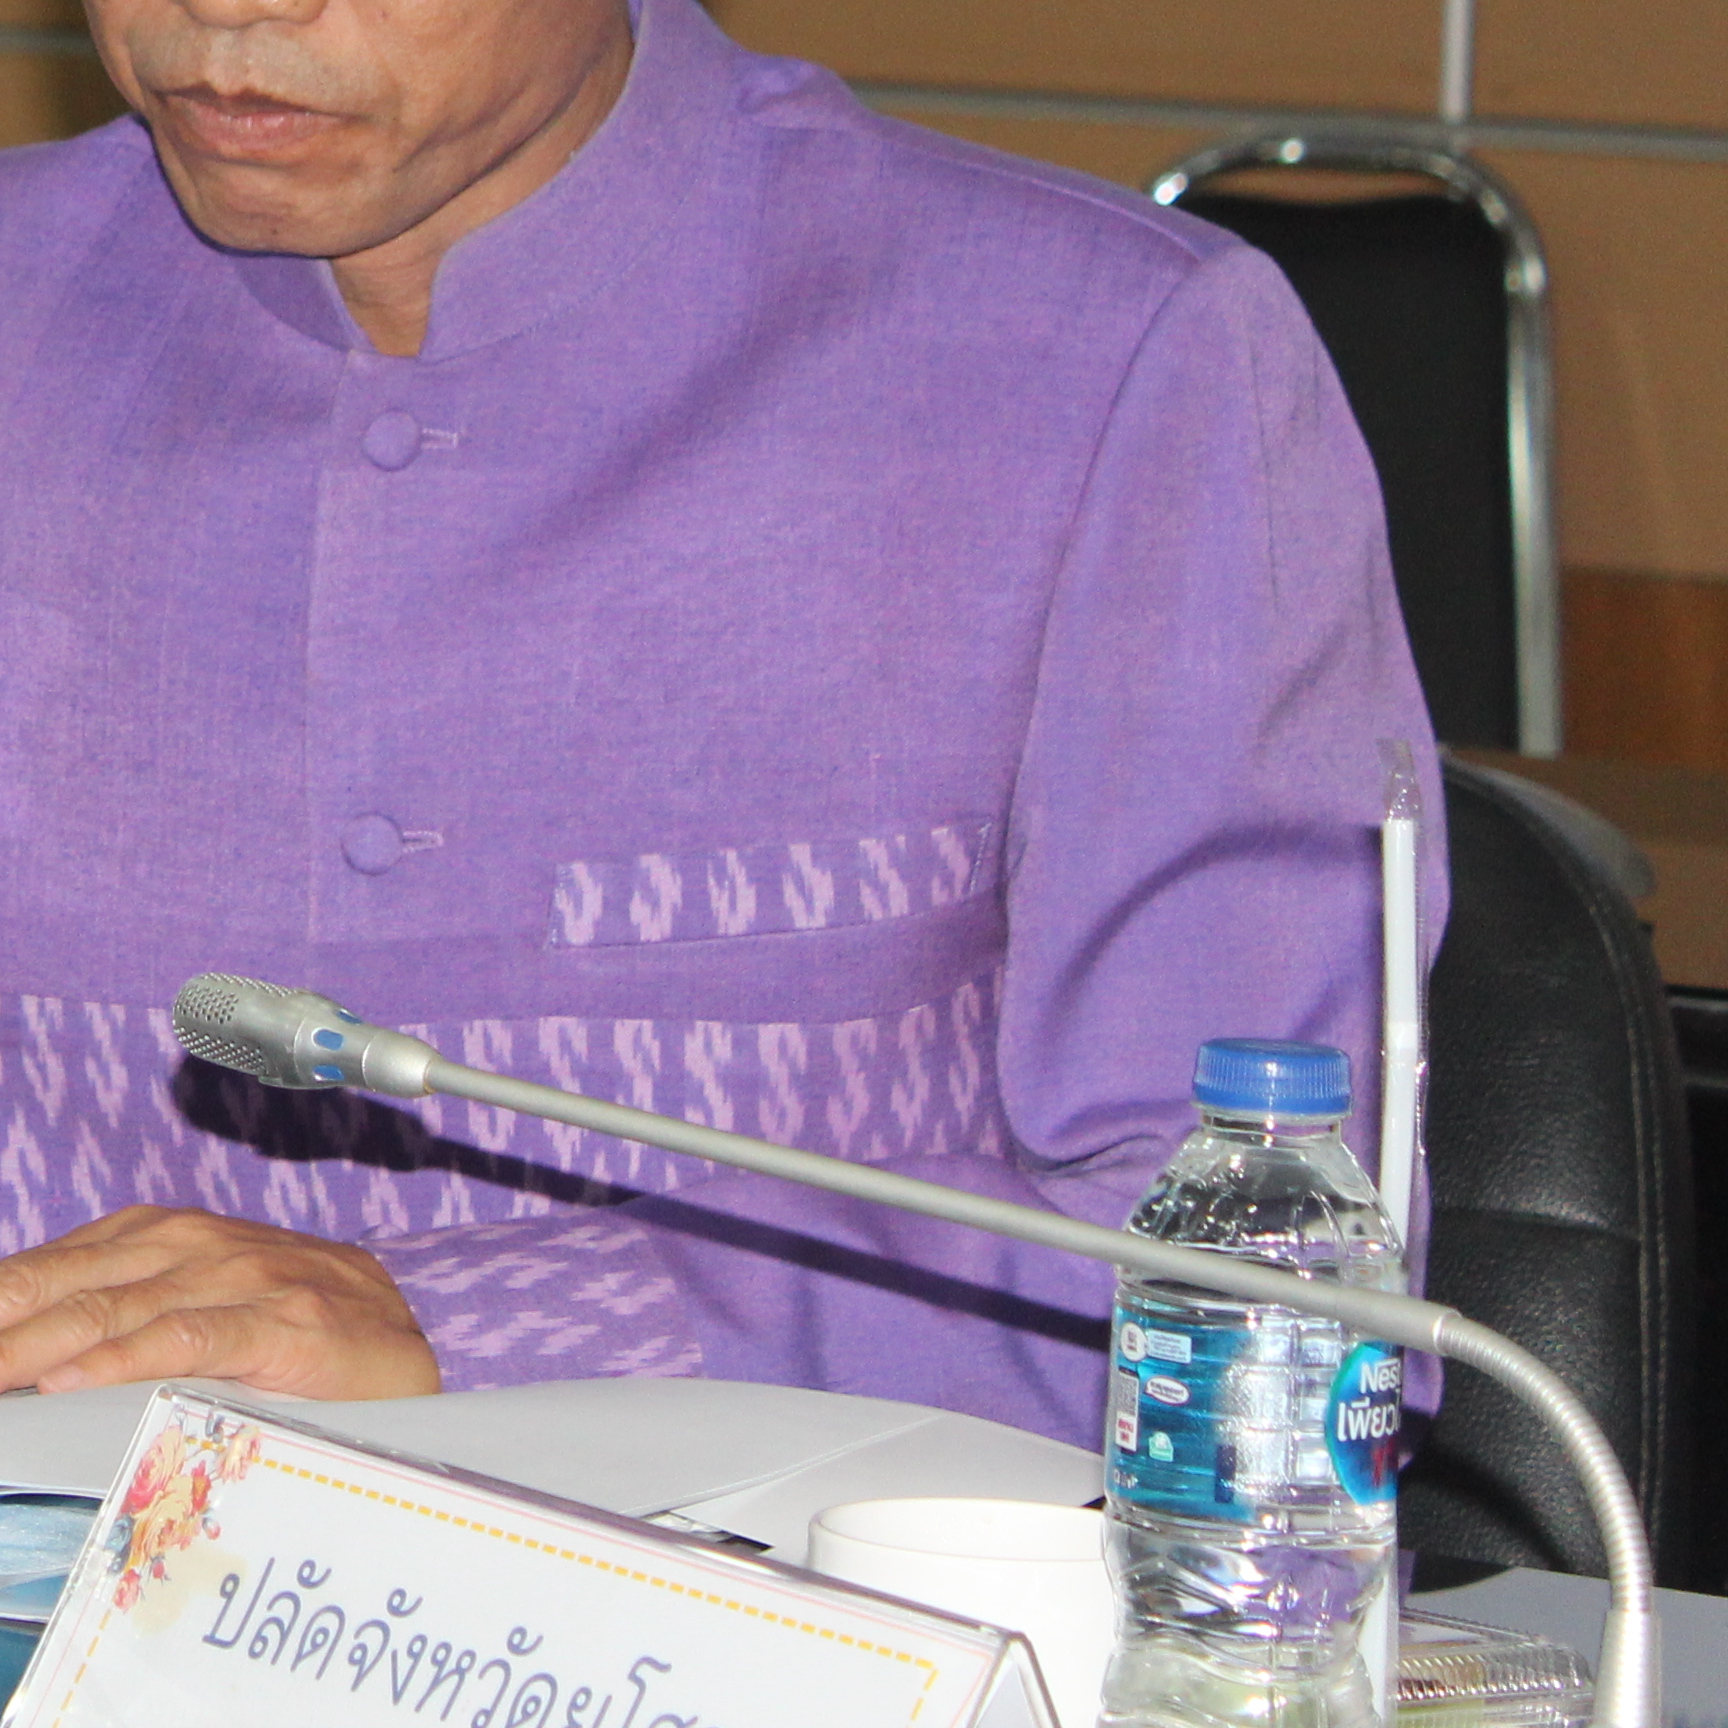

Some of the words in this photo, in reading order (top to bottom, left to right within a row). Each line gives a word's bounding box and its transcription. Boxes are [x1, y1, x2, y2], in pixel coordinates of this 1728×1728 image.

[201, 1556, 702, 1728] ปลัดจังหวัดยโ
